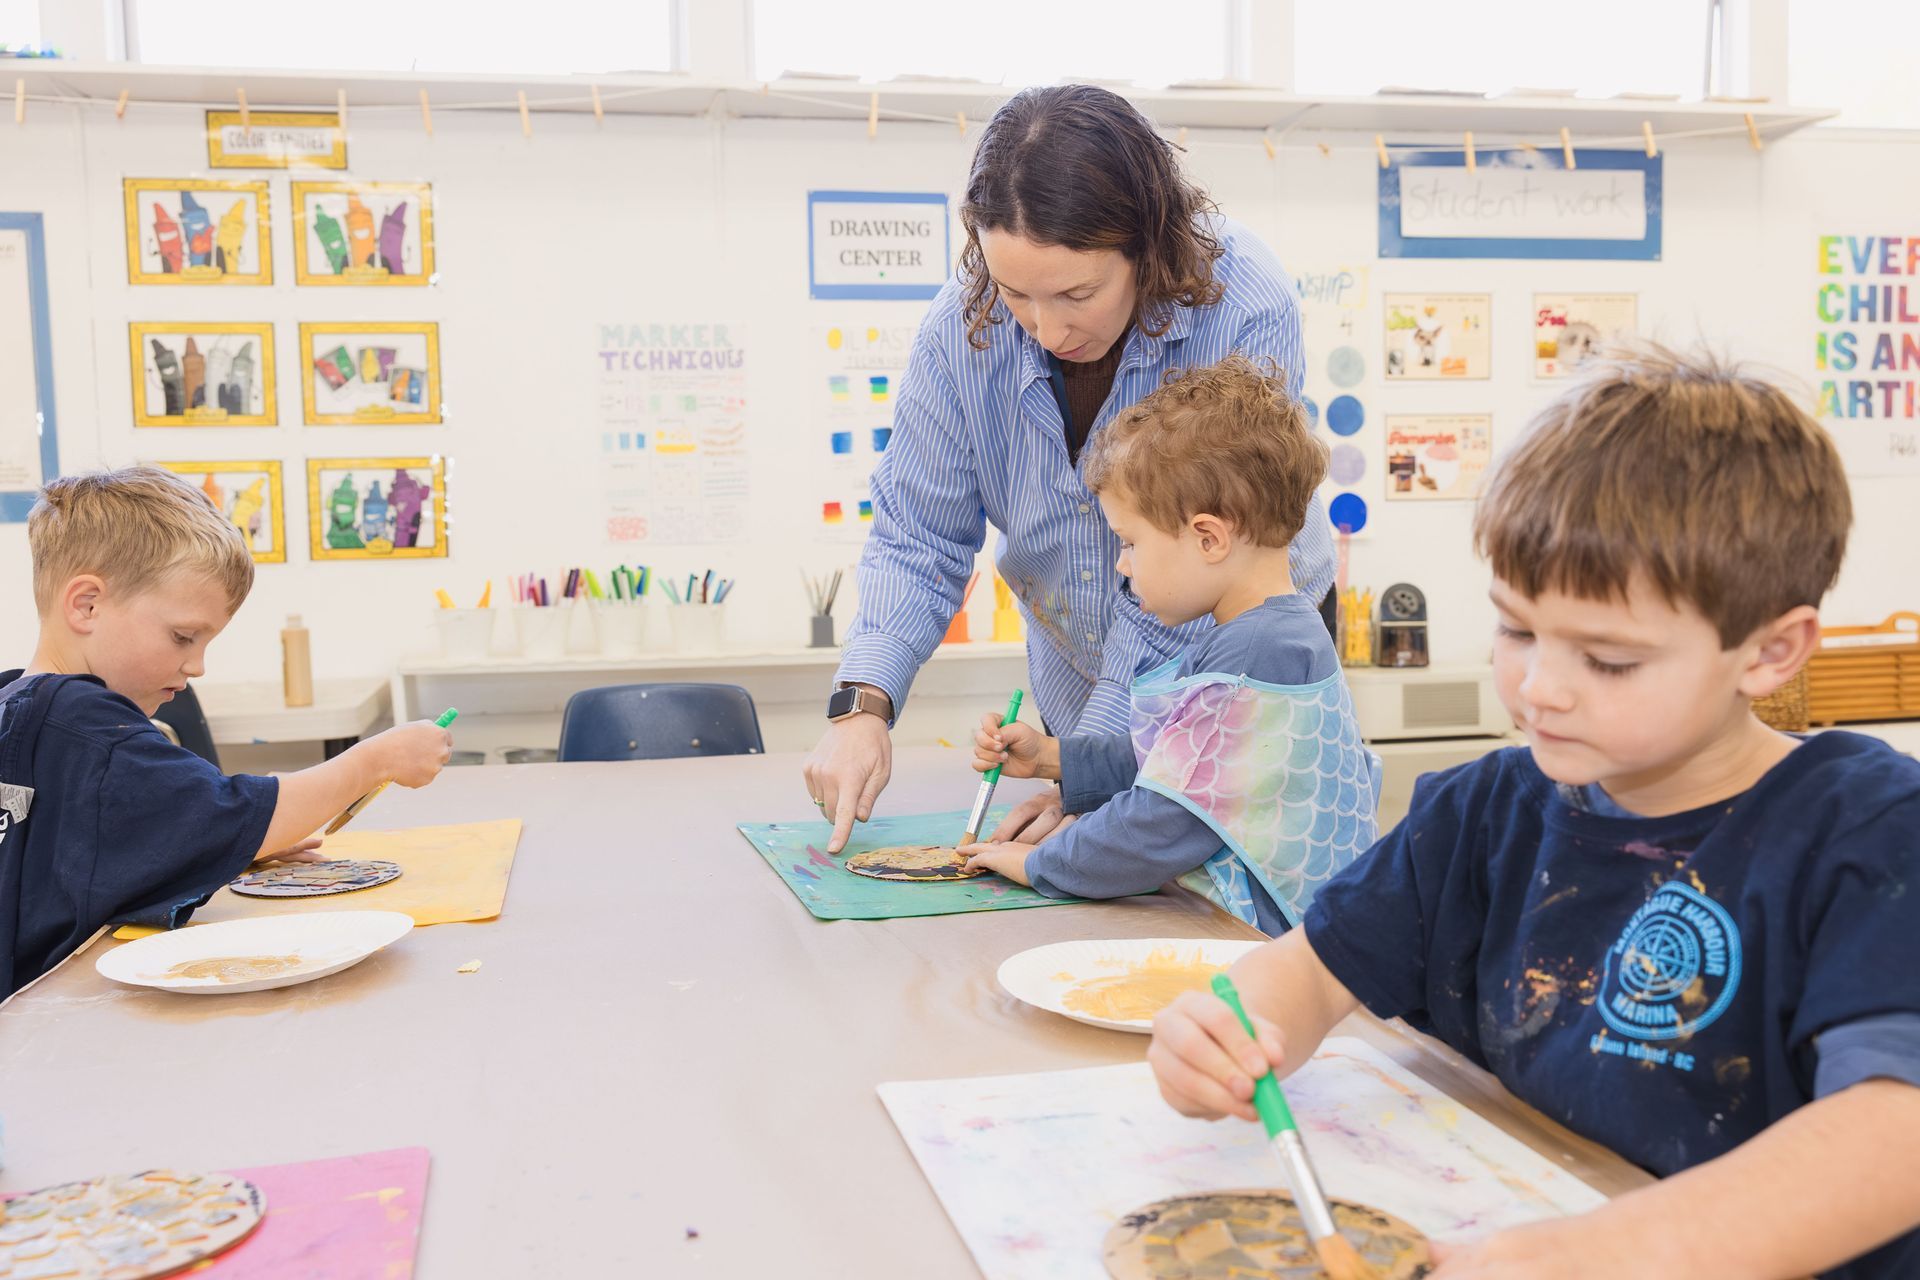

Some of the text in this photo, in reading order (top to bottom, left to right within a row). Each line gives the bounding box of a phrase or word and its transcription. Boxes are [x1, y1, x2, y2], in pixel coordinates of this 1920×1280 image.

[228, 132, 265, 149] COLOR
[1409, 177, 1630, 222] Student work
[830, 219, 930, 238] DRAWING
[839, 250, 922, 267] CENTER
[600, 322, 734, 348] MARKER
[827, 326, 861, 351] OIL
[598, 349, 745, 371] TECHNIQUES
[1816, 331, 1858, 371] IS
[1680, 902, 1726, 976] HARBOUR
[1611, 992, 1677, 1024] MARINA
